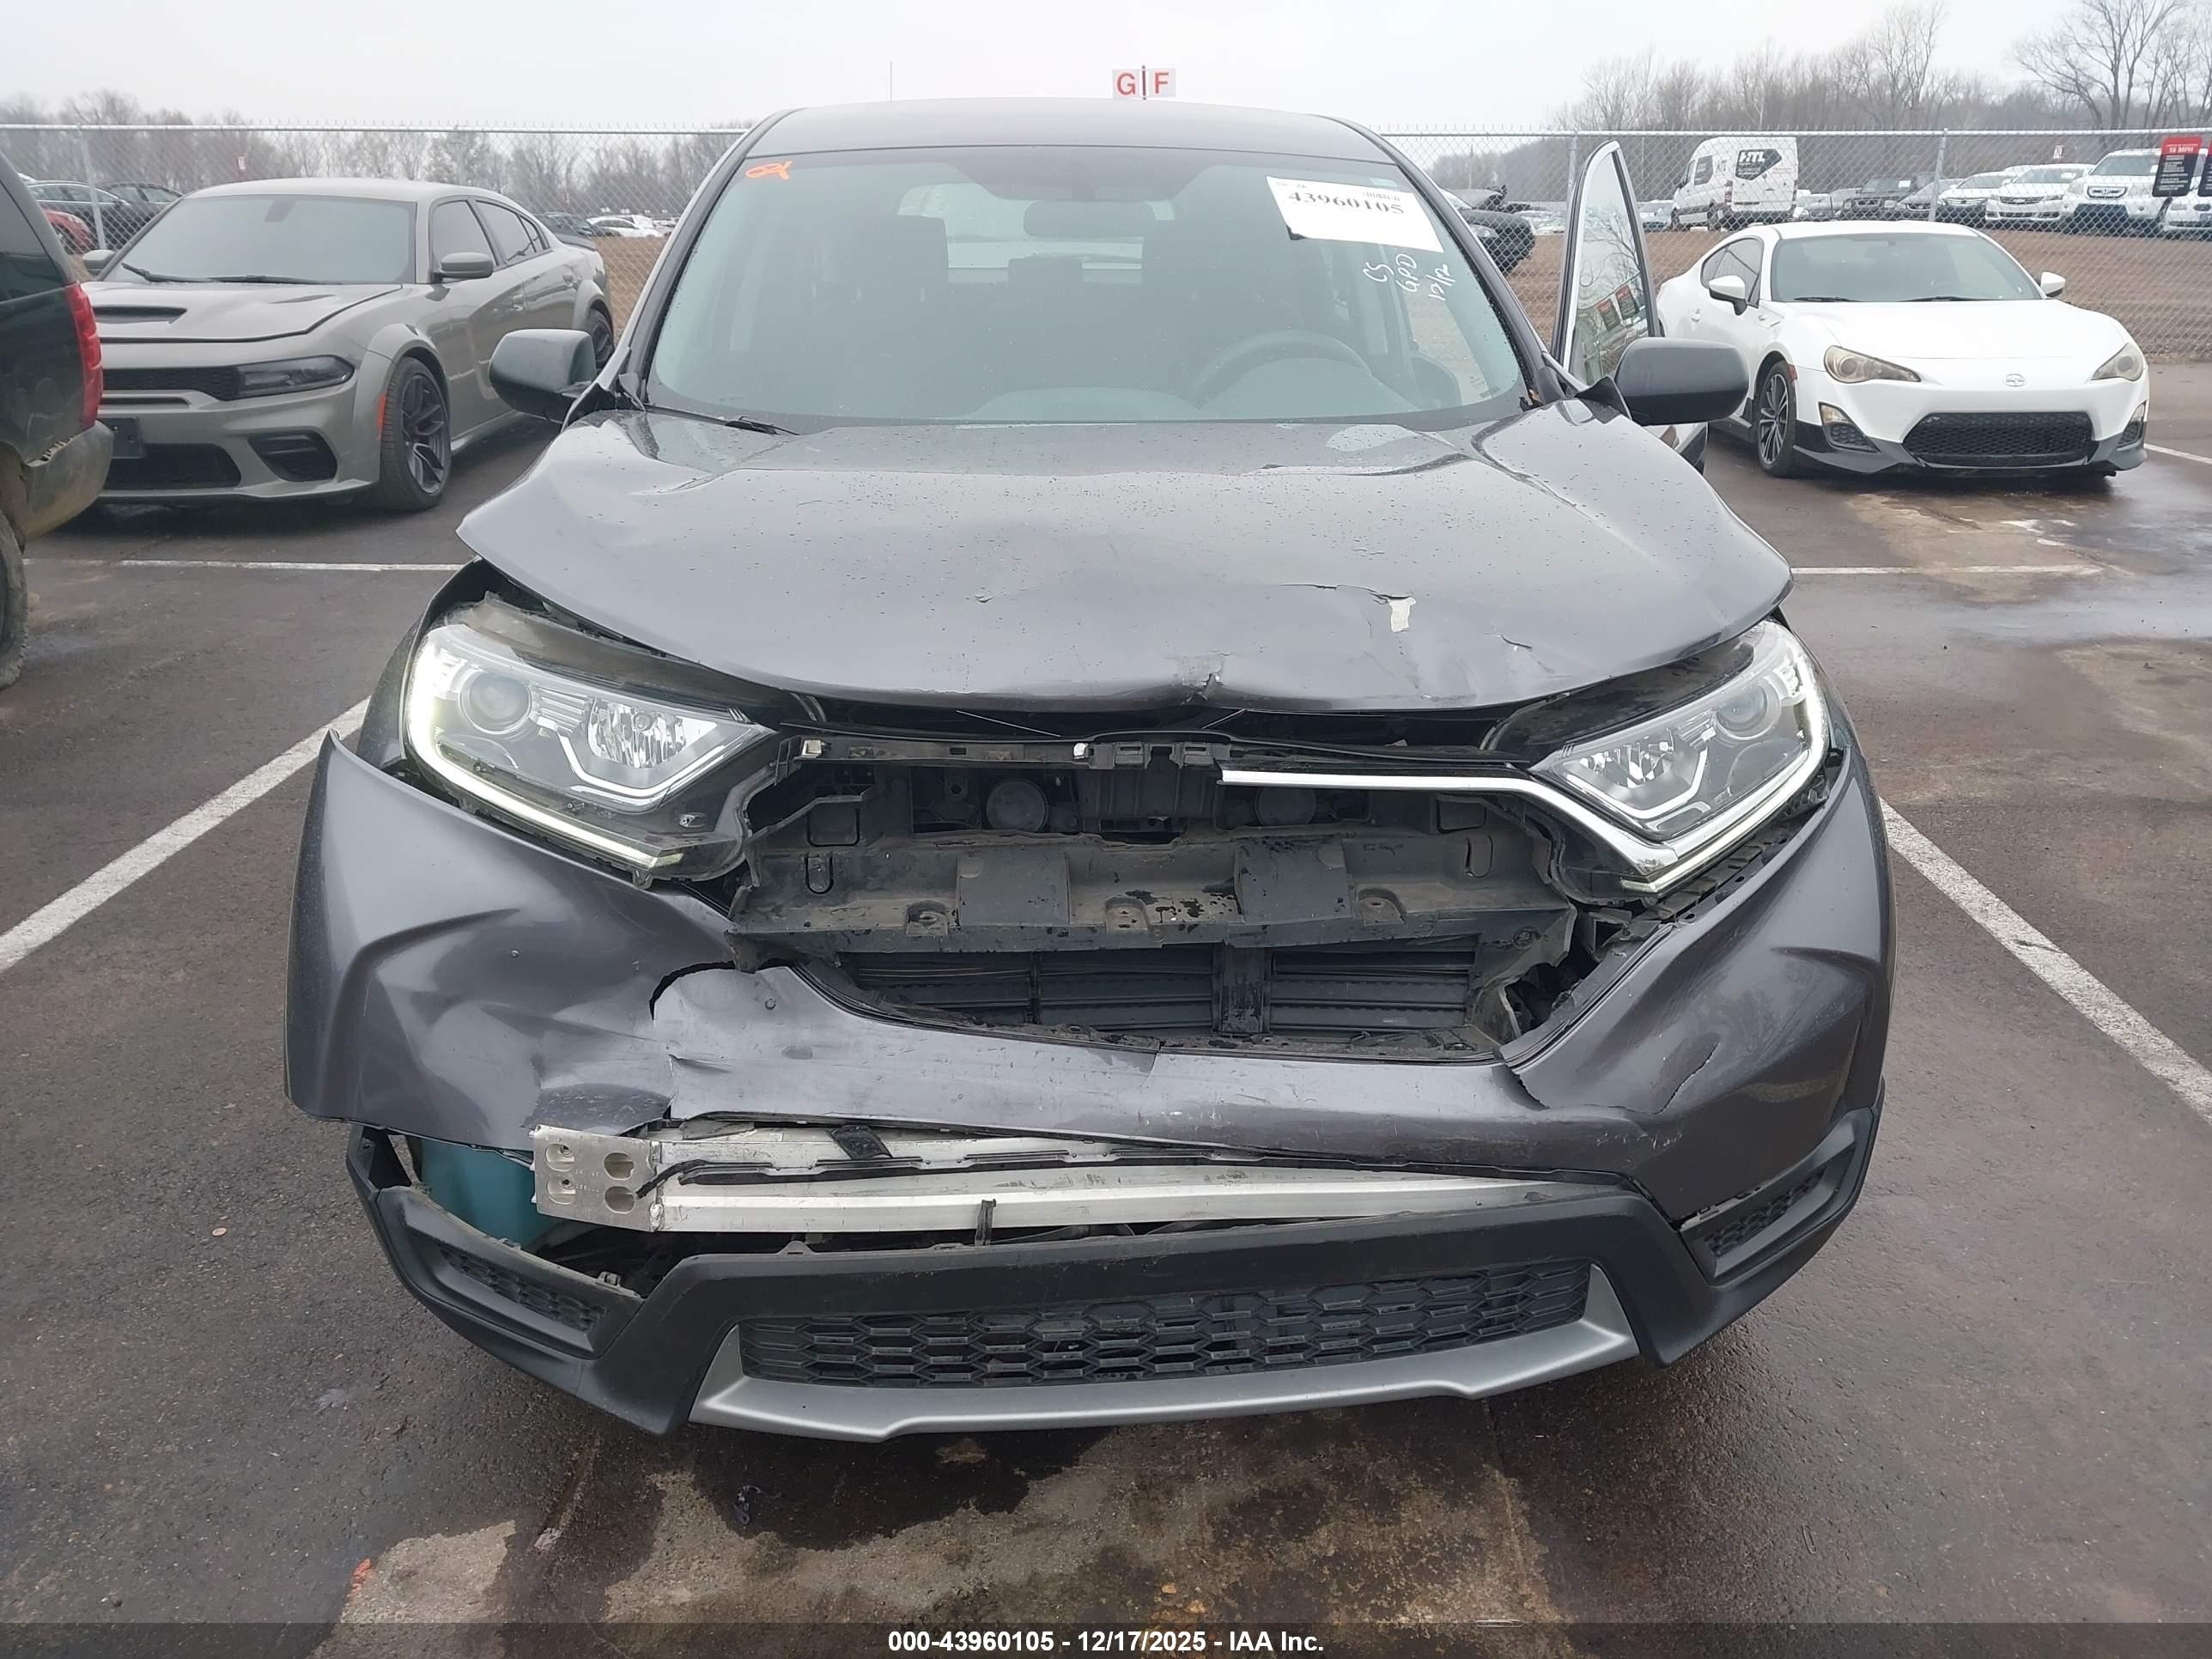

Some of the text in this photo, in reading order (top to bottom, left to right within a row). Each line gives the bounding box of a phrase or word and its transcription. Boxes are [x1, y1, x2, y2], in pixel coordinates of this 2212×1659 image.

[1116, 72, 1136, 95] G
[1155, 72, 1170, 94] F
[1289, 191, 1405, 214] 43960105
